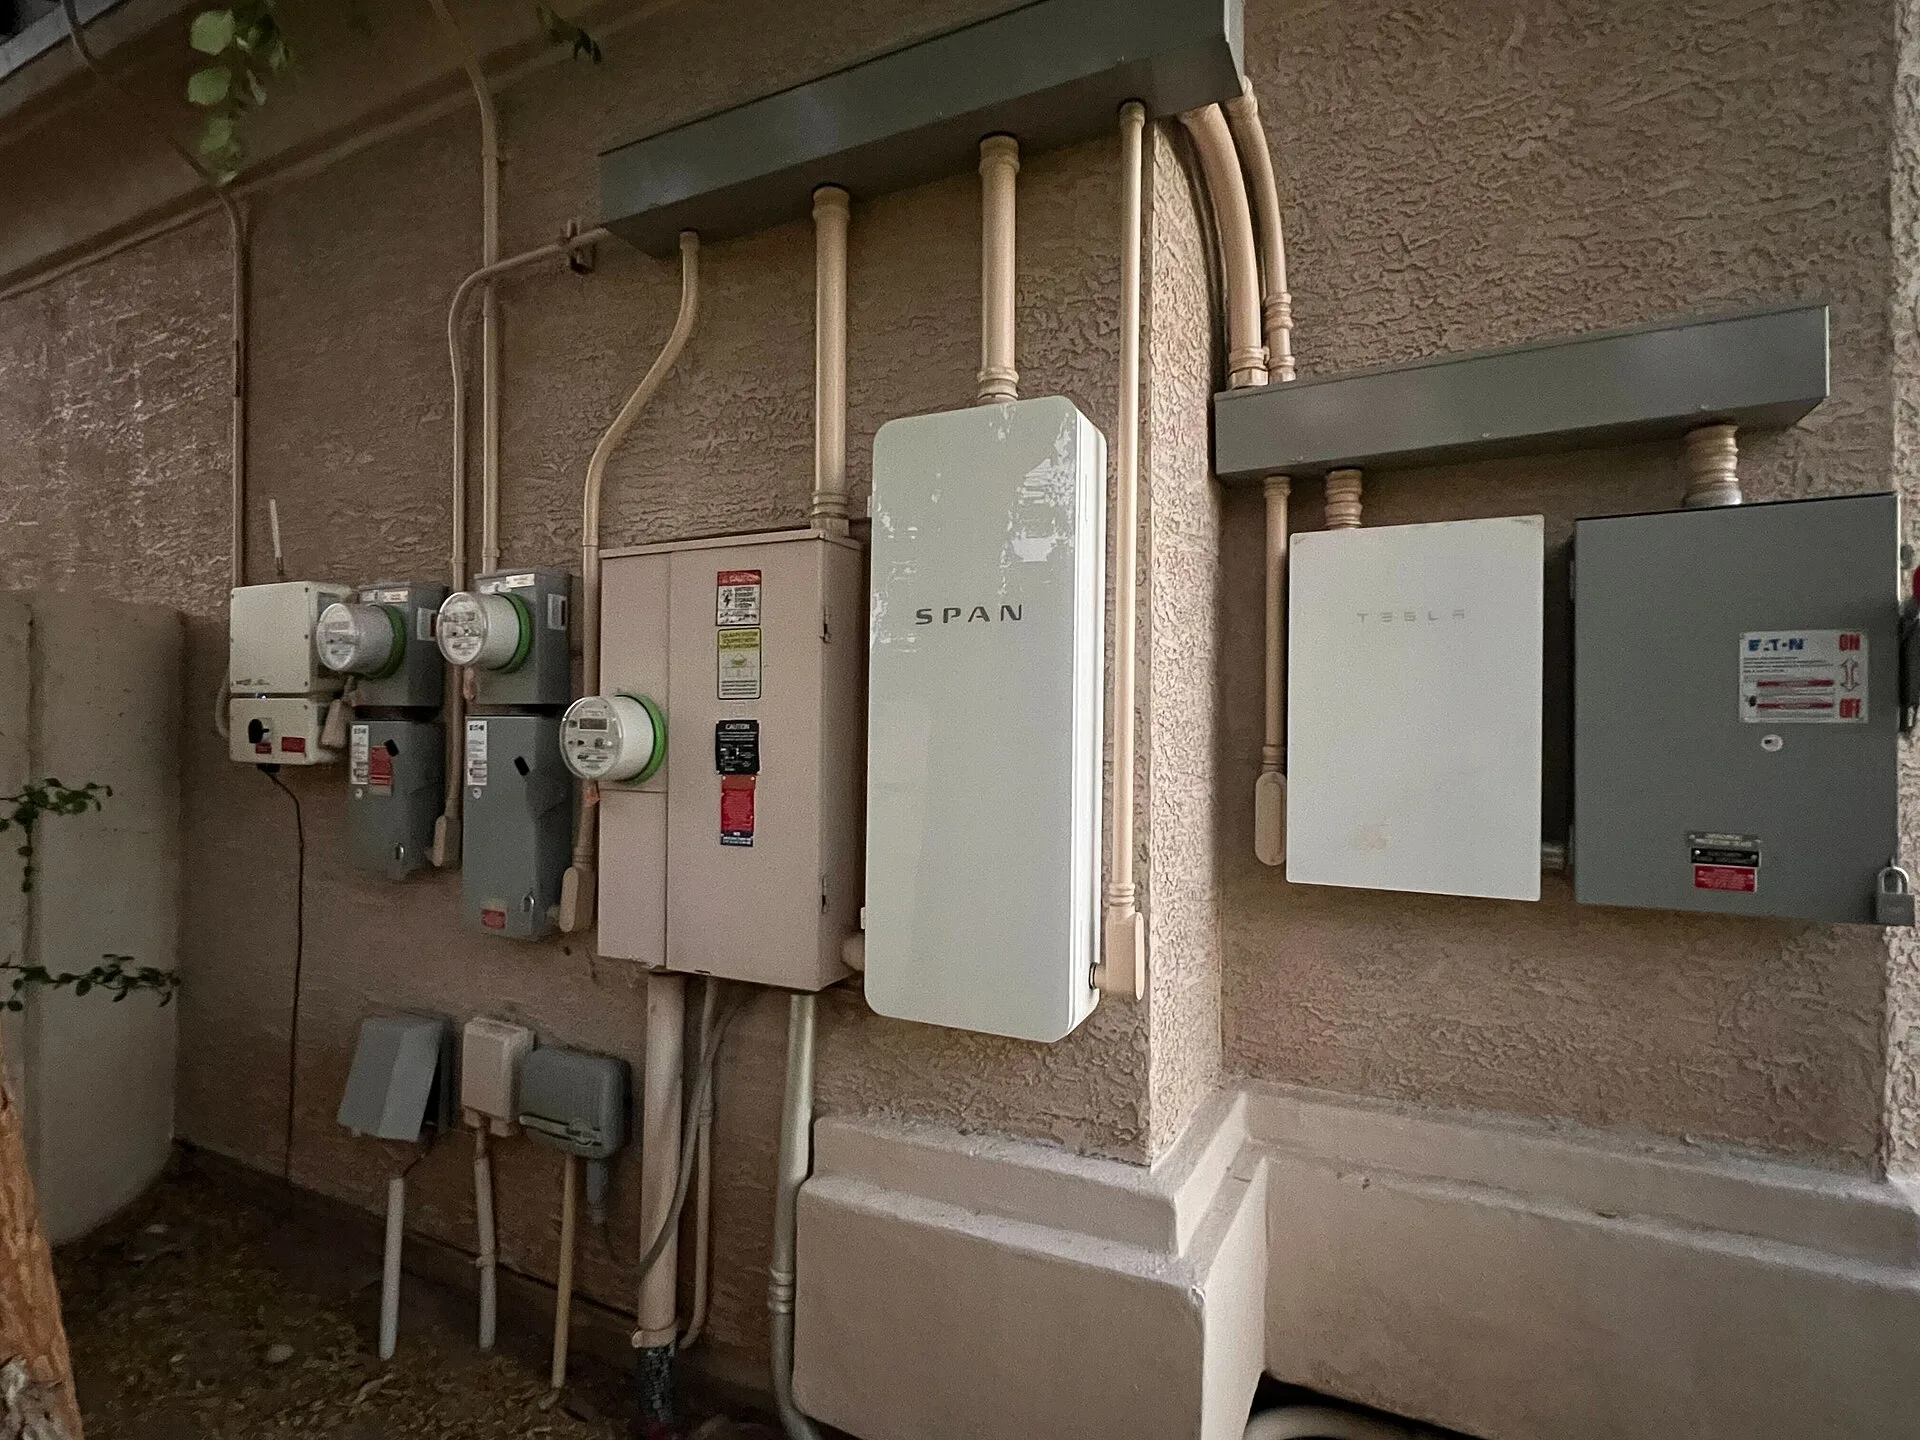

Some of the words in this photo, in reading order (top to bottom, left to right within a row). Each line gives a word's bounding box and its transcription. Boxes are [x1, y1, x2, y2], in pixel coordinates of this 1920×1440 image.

[915, 604, 1022, 625] SPAN
[1356, 609, 1465, 624] TESLA
[1839, 633, 1860, 651] ON
[1839, 698, 1861, 718] OFF
